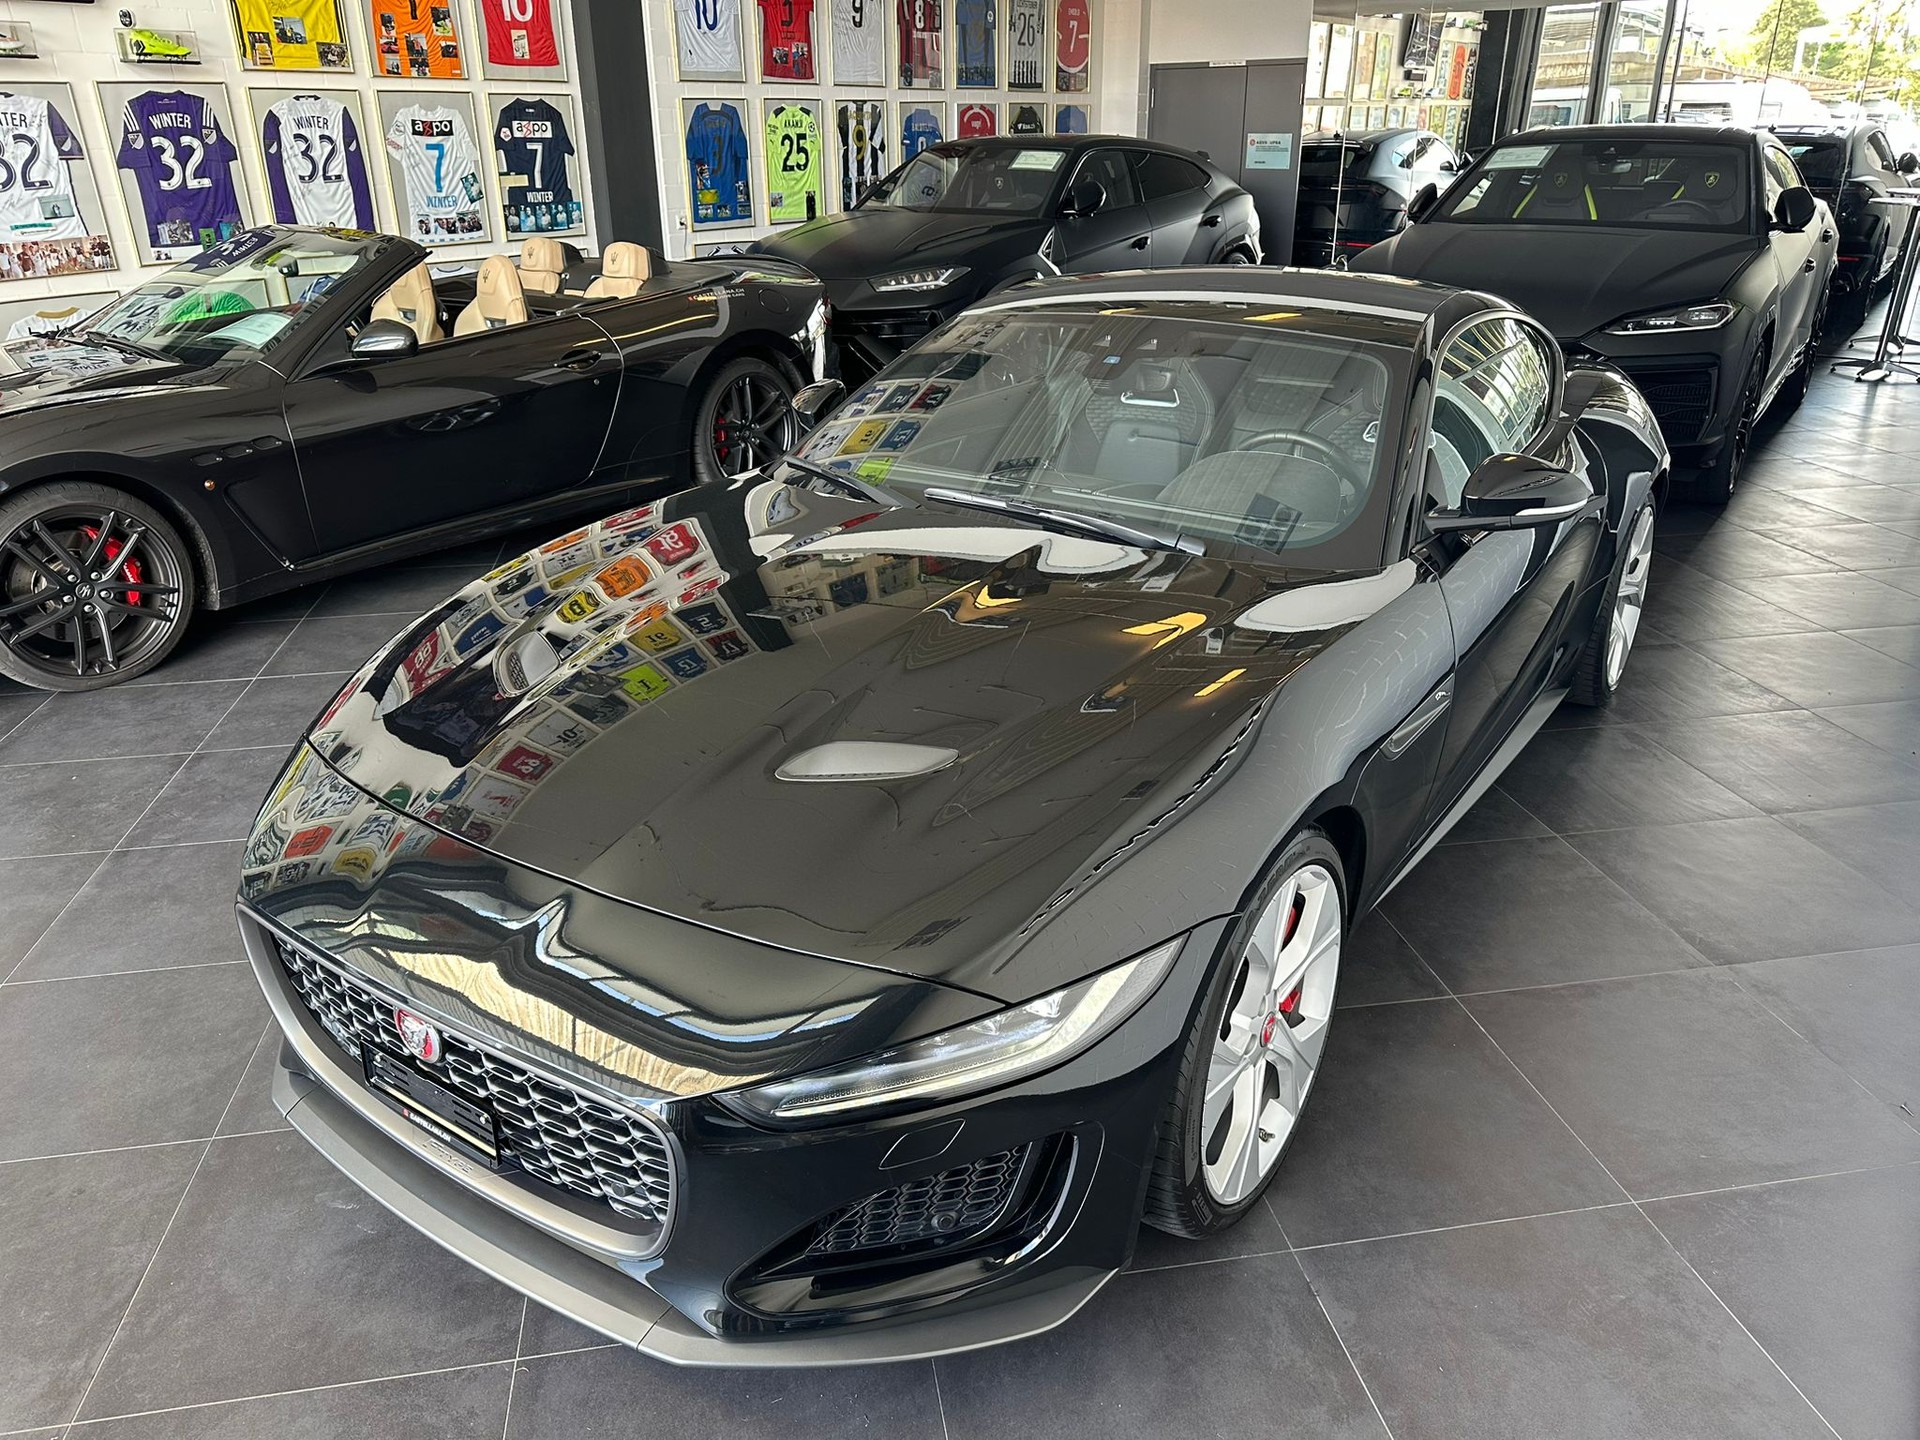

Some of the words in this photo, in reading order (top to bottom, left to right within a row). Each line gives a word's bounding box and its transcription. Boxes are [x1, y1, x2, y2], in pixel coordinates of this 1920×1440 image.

[1017, 12, 1035, 47] 26
[1069, 20, 1078, 53] 7
[0, 111, 28, 128] TER
[148, 112, 192, 130] WINTER
[293, 115, 329, 130] WINTER
[292, 132, 345, 184] 32
[780, 133, 810, 173] 25
[851, 124, 867, 161] 9
[150, 135, 213, 191] 32
[425, 143, 445, 193] 7
[526, 142, 543, 189] 7
[426, 195, 458, 208] WINTER
[526, 190, 554, 203] WINTER
